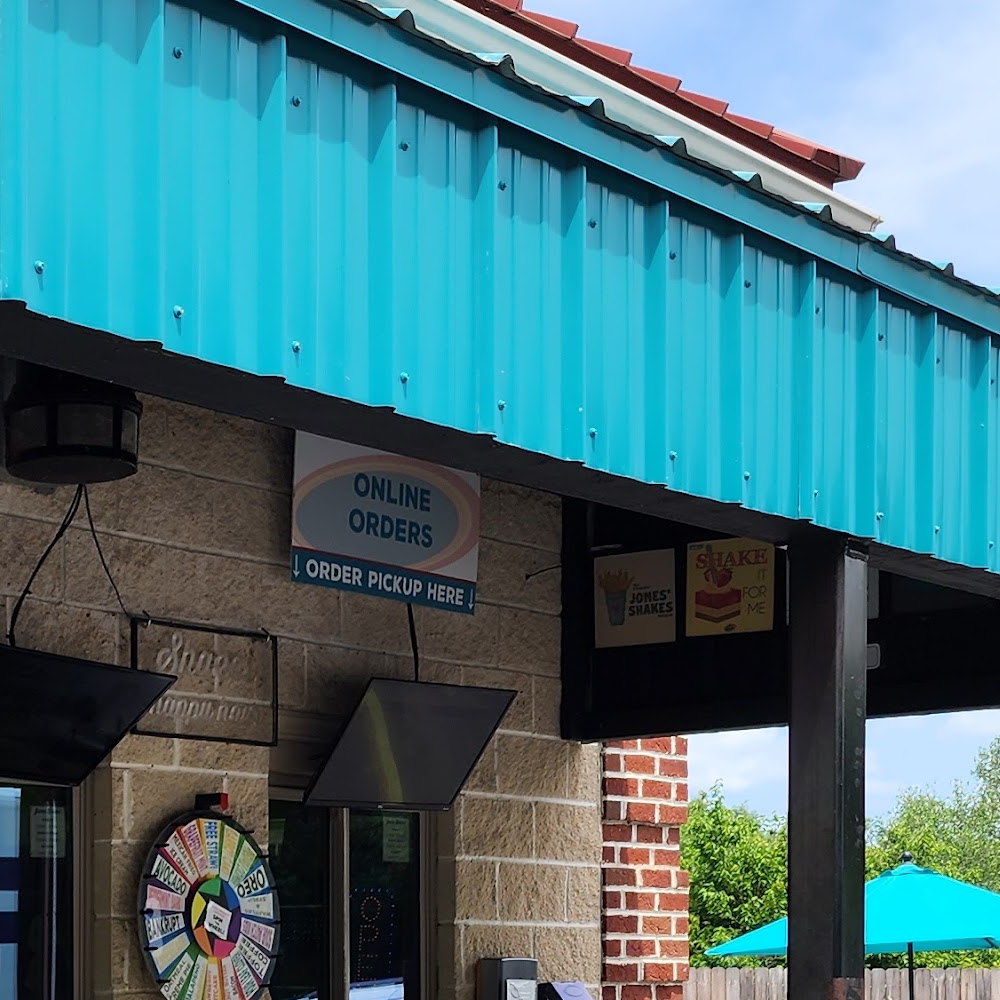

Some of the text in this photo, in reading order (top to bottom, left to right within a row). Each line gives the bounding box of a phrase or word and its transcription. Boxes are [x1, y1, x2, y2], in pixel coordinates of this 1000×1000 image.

[353, 472, 431, 512] ONLINE
[348, 508, 433, 548] ORDERS
[696, 548, 768, 569] SHAKE
[305, 558, 465, 606] ORDER PICKUP HERE
[743, 584, 768, 600] FOR
[628, 601, 674, 616] SHAKES
[629, 589, 671, 604] JONES'
[747, 600, 767, 615] ME
[204, 821, 218, 839] FREE
[154, 859, 187, 896] AVOCADO
[237, 870, 265, 897] OREO
[242, 936, 268, 965] COFFEE
[357, 895, 381, 981] OPE
[239, 944, 263, 977] TOFFEE
